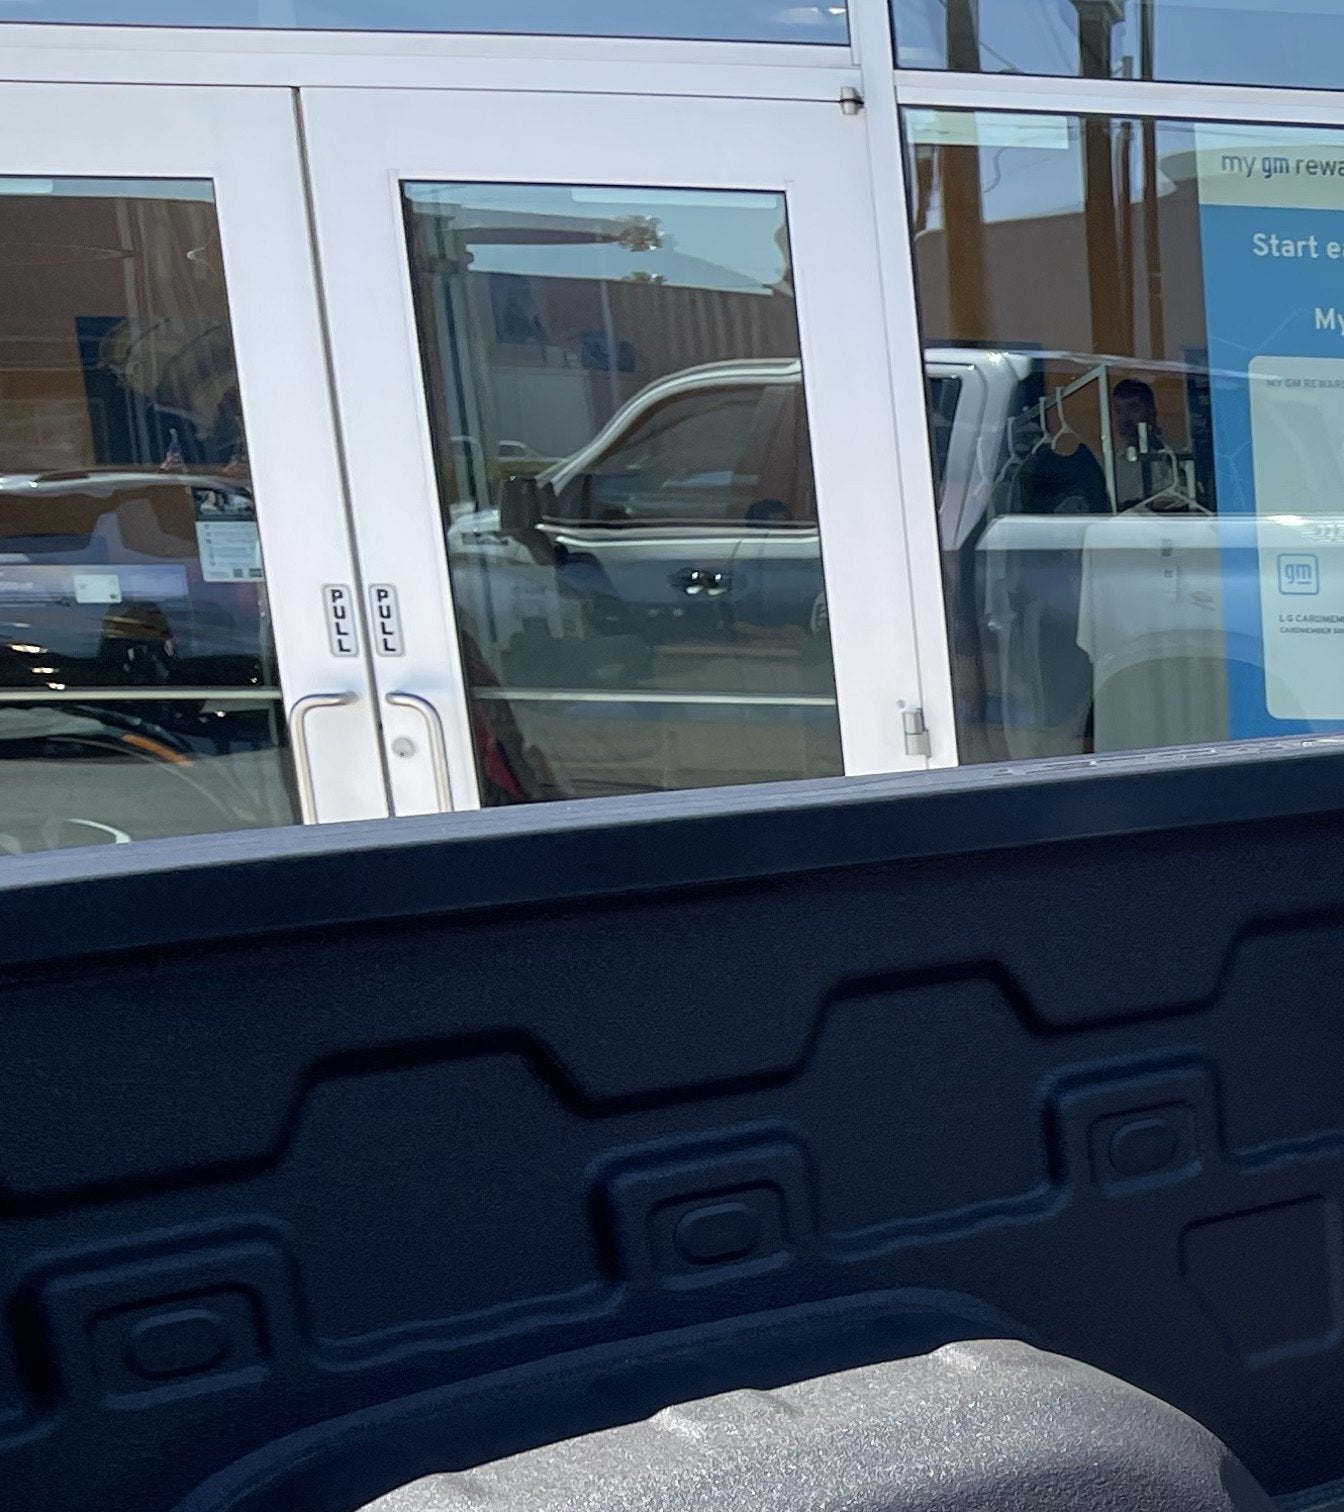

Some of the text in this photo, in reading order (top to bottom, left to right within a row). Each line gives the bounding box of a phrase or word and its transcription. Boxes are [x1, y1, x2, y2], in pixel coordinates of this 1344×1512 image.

[1221, 155, 1256, 177] my
[1261, 156, 1290, 178] gm
[1252, 232, 1319, 258] Start
[1285, 564, 1312, 584] gm
[330, 589, 351, 652] PULL
[376, 588, 396, 651] PULL
